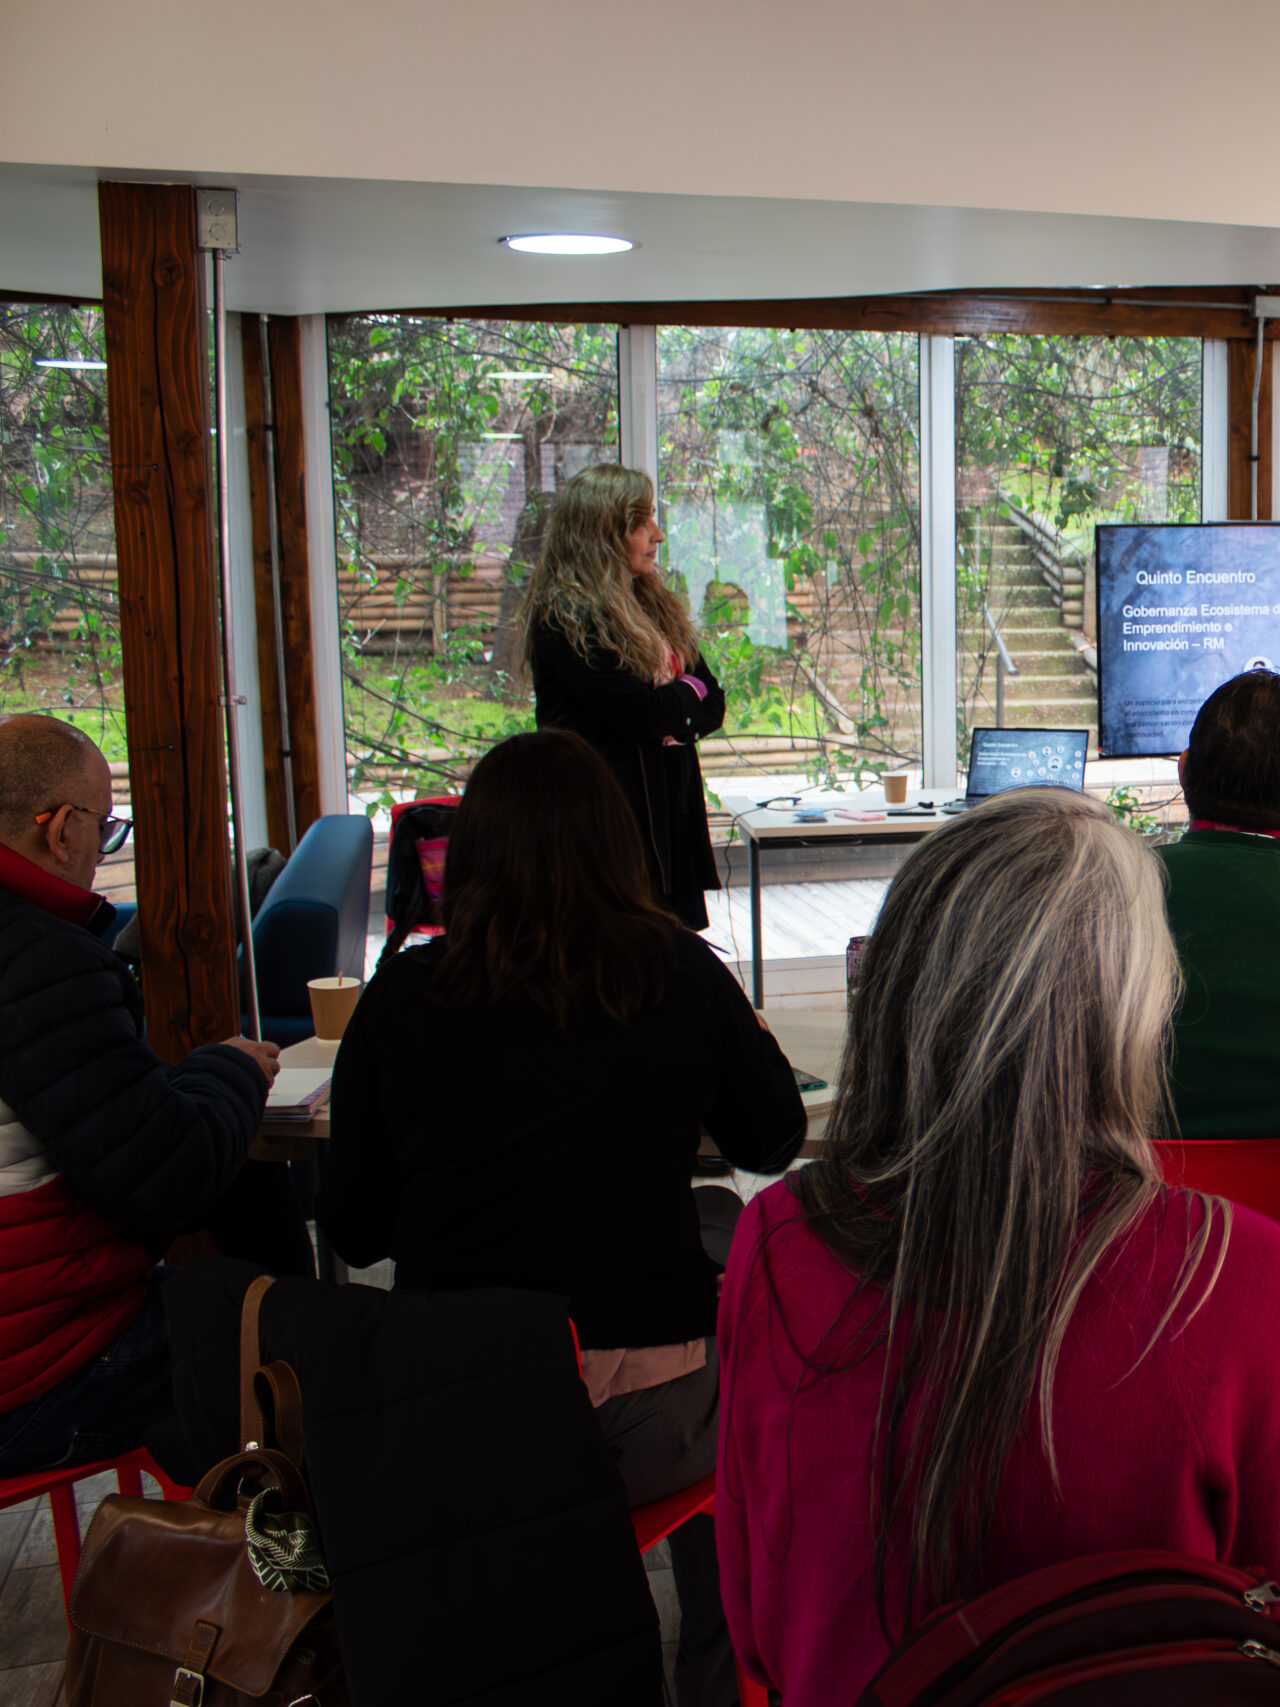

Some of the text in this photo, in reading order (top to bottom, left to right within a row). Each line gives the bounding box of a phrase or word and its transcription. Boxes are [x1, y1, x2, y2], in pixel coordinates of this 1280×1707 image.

[1136, 570, 1256, 585] Quinto Encuentro
[1122, 605, 1197, 617] Gobernanza
[1201, 604, 1270, 616] Ecosistema
[1123, 622, 1233, 636] Emprendimiento e
[1123, 638, 1189, 651] Innovación
[1203, 637, 1225, 650] RM
